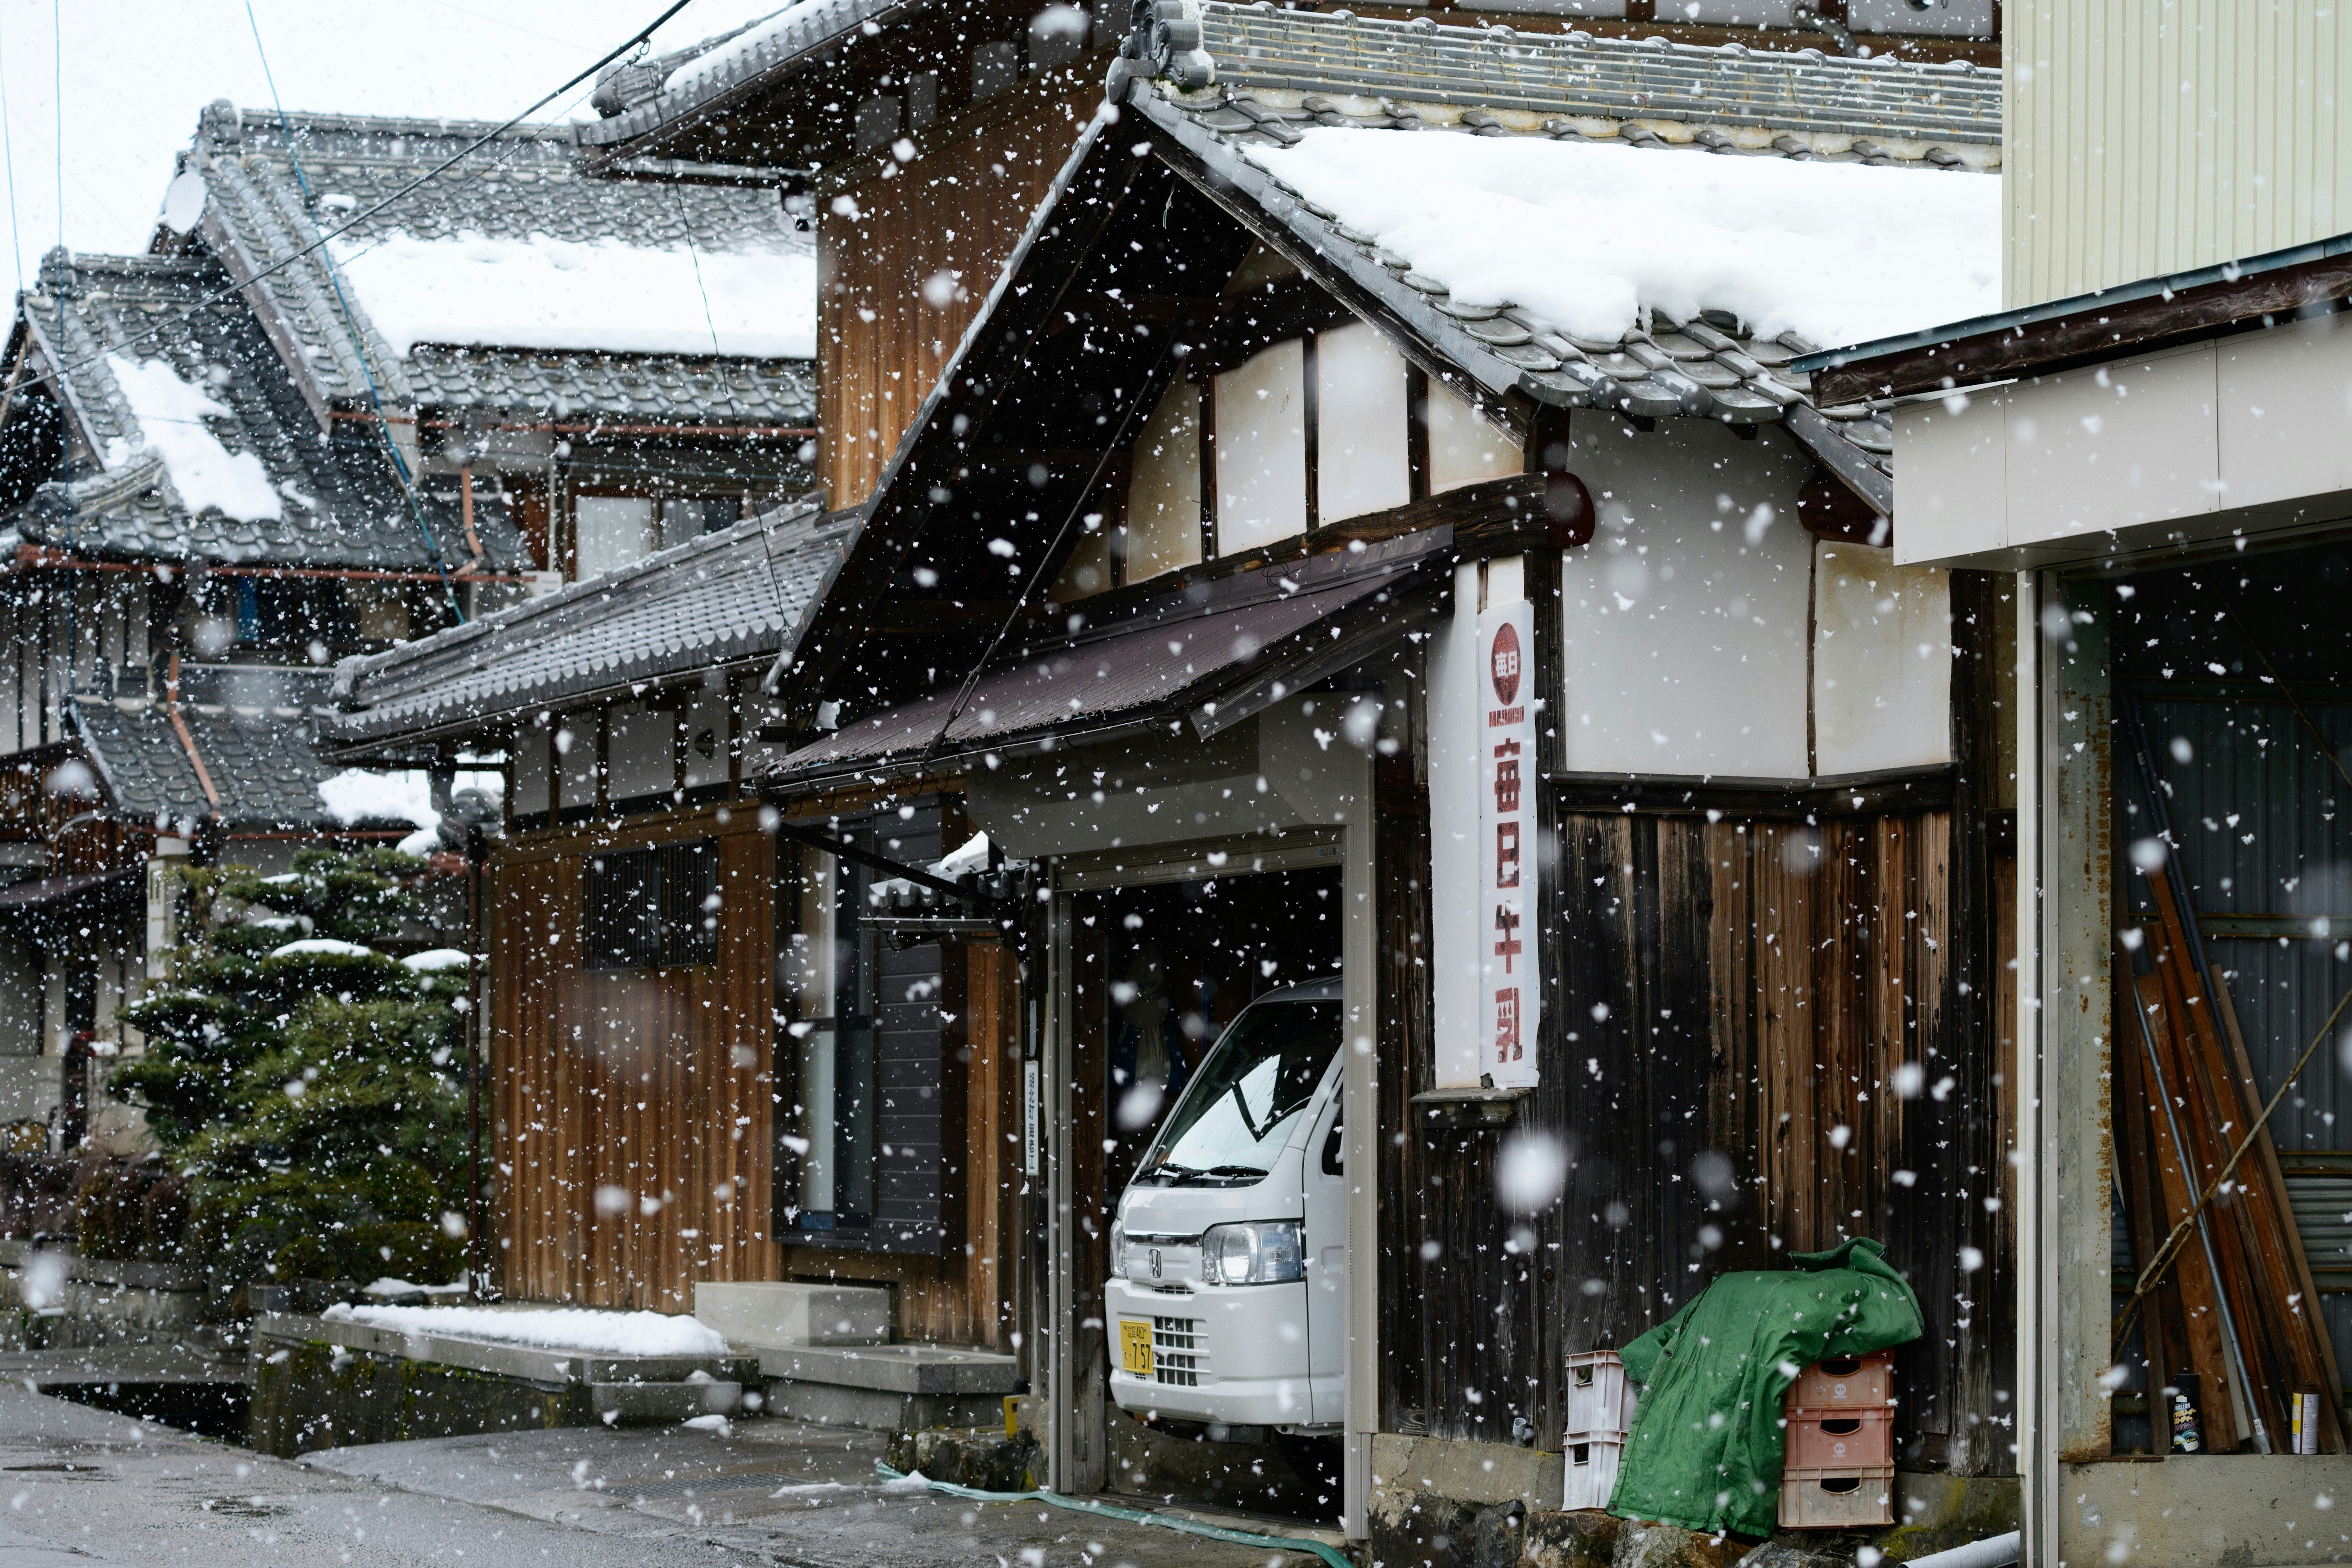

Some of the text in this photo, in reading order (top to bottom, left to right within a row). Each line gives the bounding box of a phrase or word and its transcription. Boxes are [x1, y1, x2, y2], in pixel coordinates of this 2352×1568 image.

[1495, 651, 1517, 677] 毎日
[1489, 706, 1524, 727] MAINICHI
[1494, 738, 1522, 1063] 毎日牛乳
